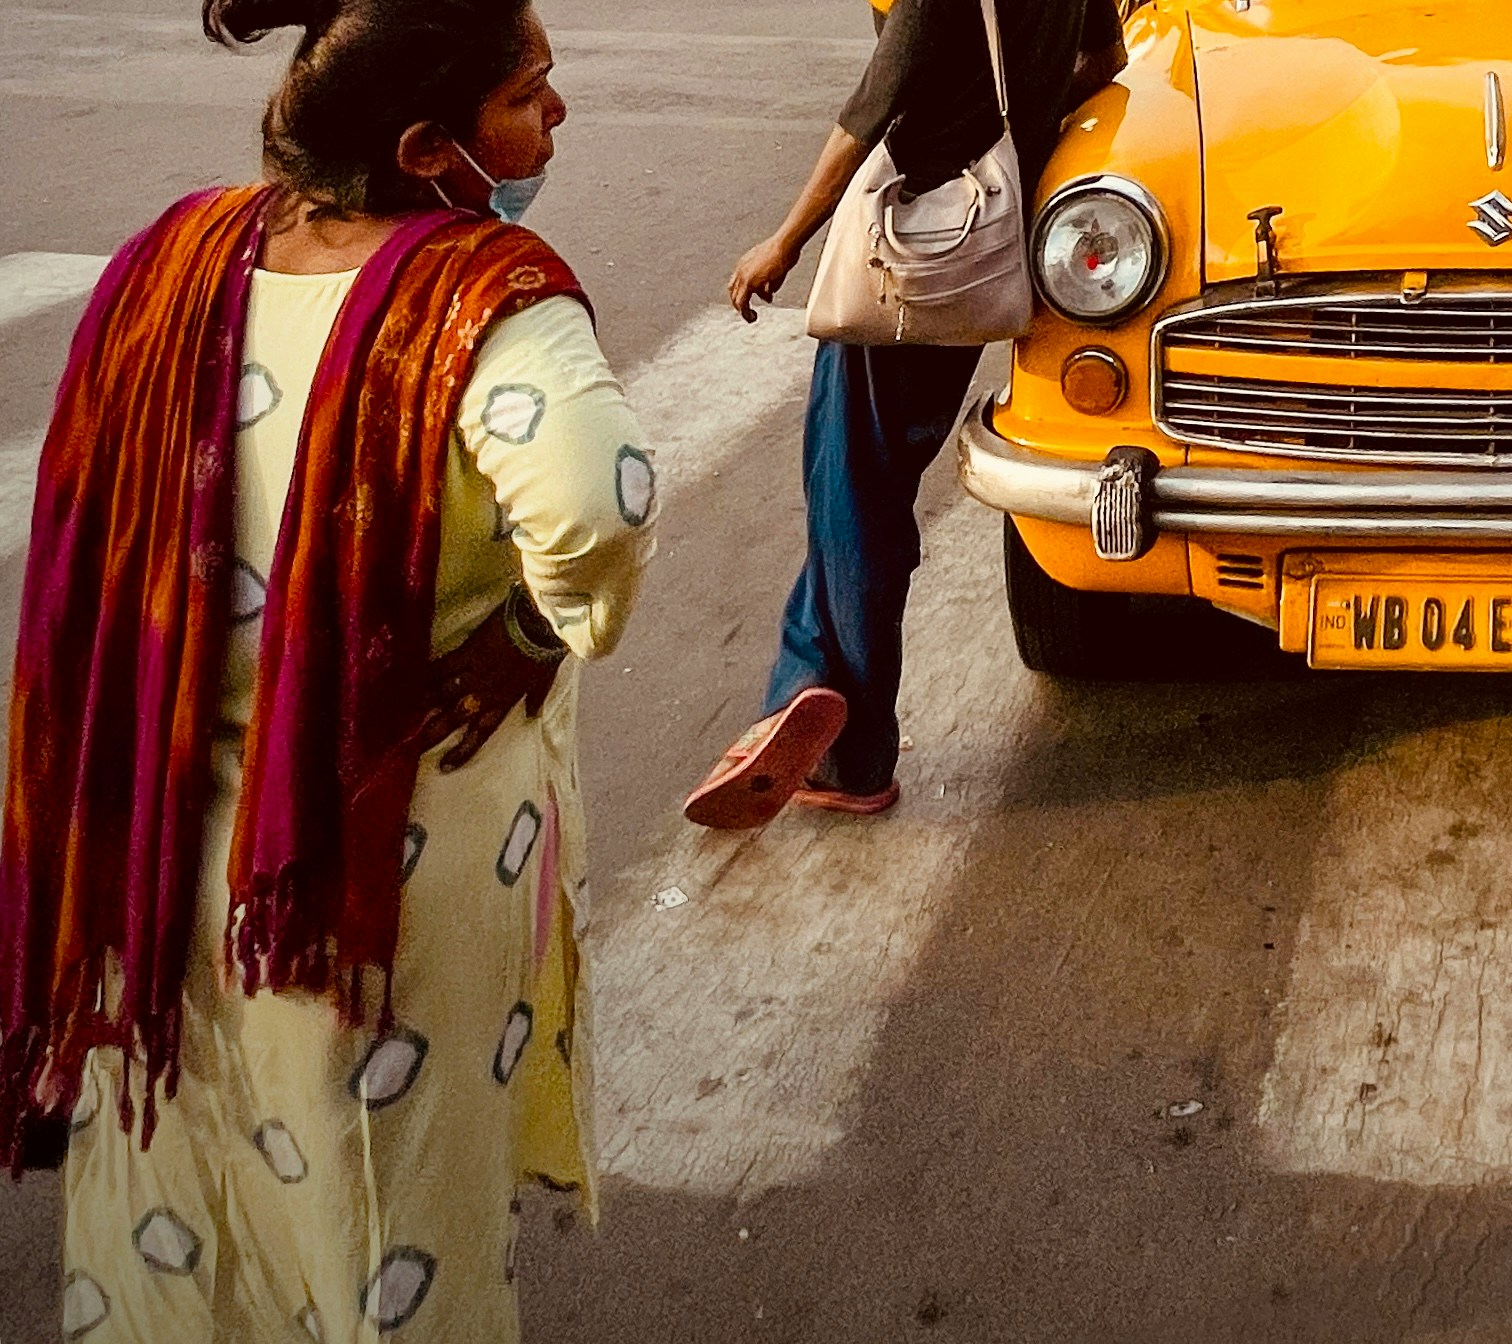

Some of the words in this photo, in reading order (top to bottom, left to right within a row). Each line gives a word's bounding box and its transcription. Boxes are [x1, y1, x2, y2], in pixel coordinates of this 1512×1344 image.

[1320, 614, 1346, 630] IND
[1352, 594, 1408, 651] WB
[1420, 596, 1476, 652] 04
